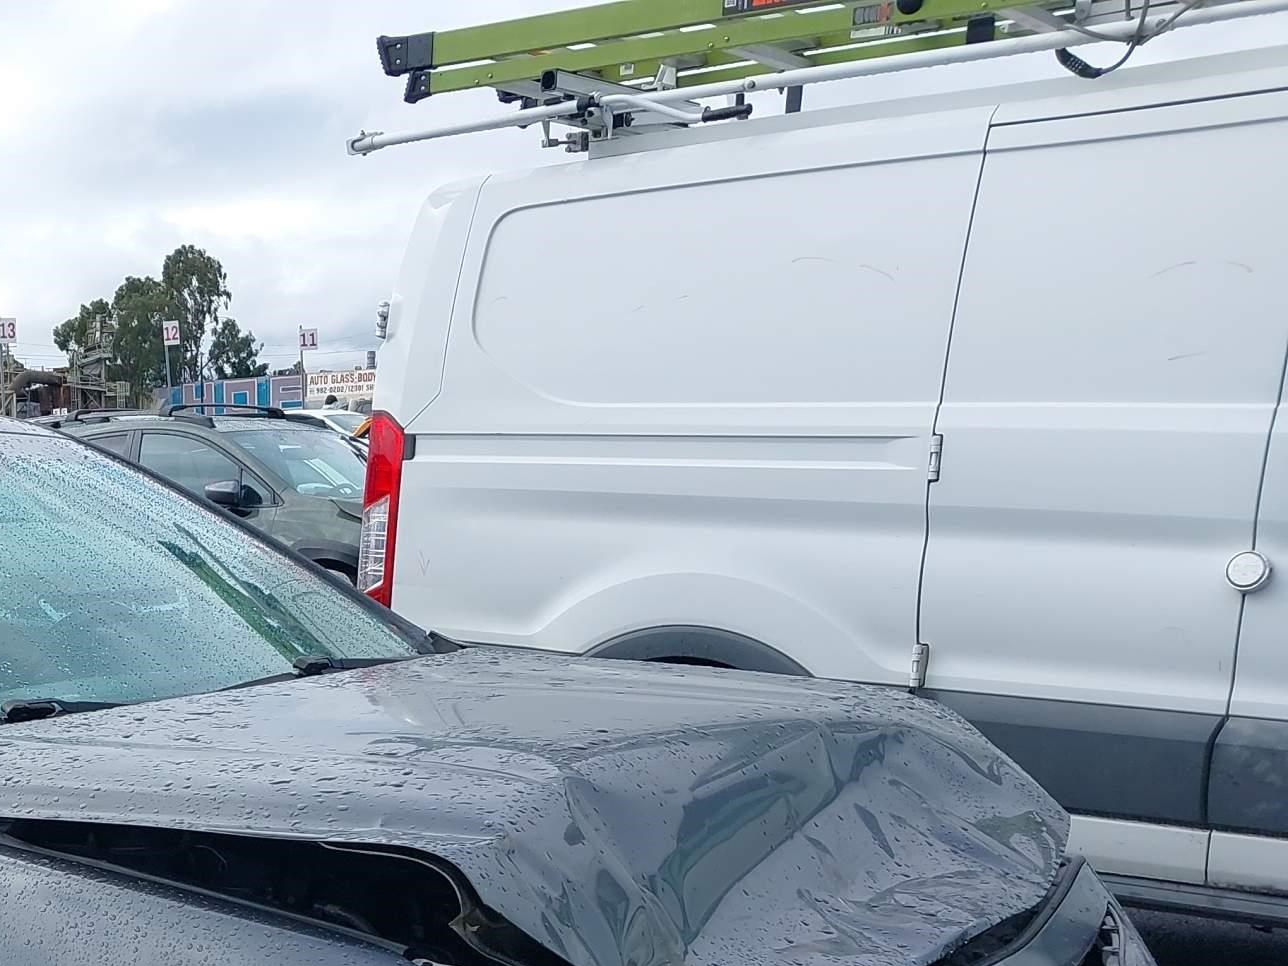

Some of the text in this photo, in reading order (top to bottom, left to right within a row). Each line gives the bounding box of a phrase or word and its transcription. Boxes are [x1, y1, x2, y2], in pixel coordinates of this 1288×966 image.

[0, 322, 16, 339] 13
[164, 326, 179, 342] 12
[300, 333, 317, 347] 11
[309, 374, 328, 386] AUTO
